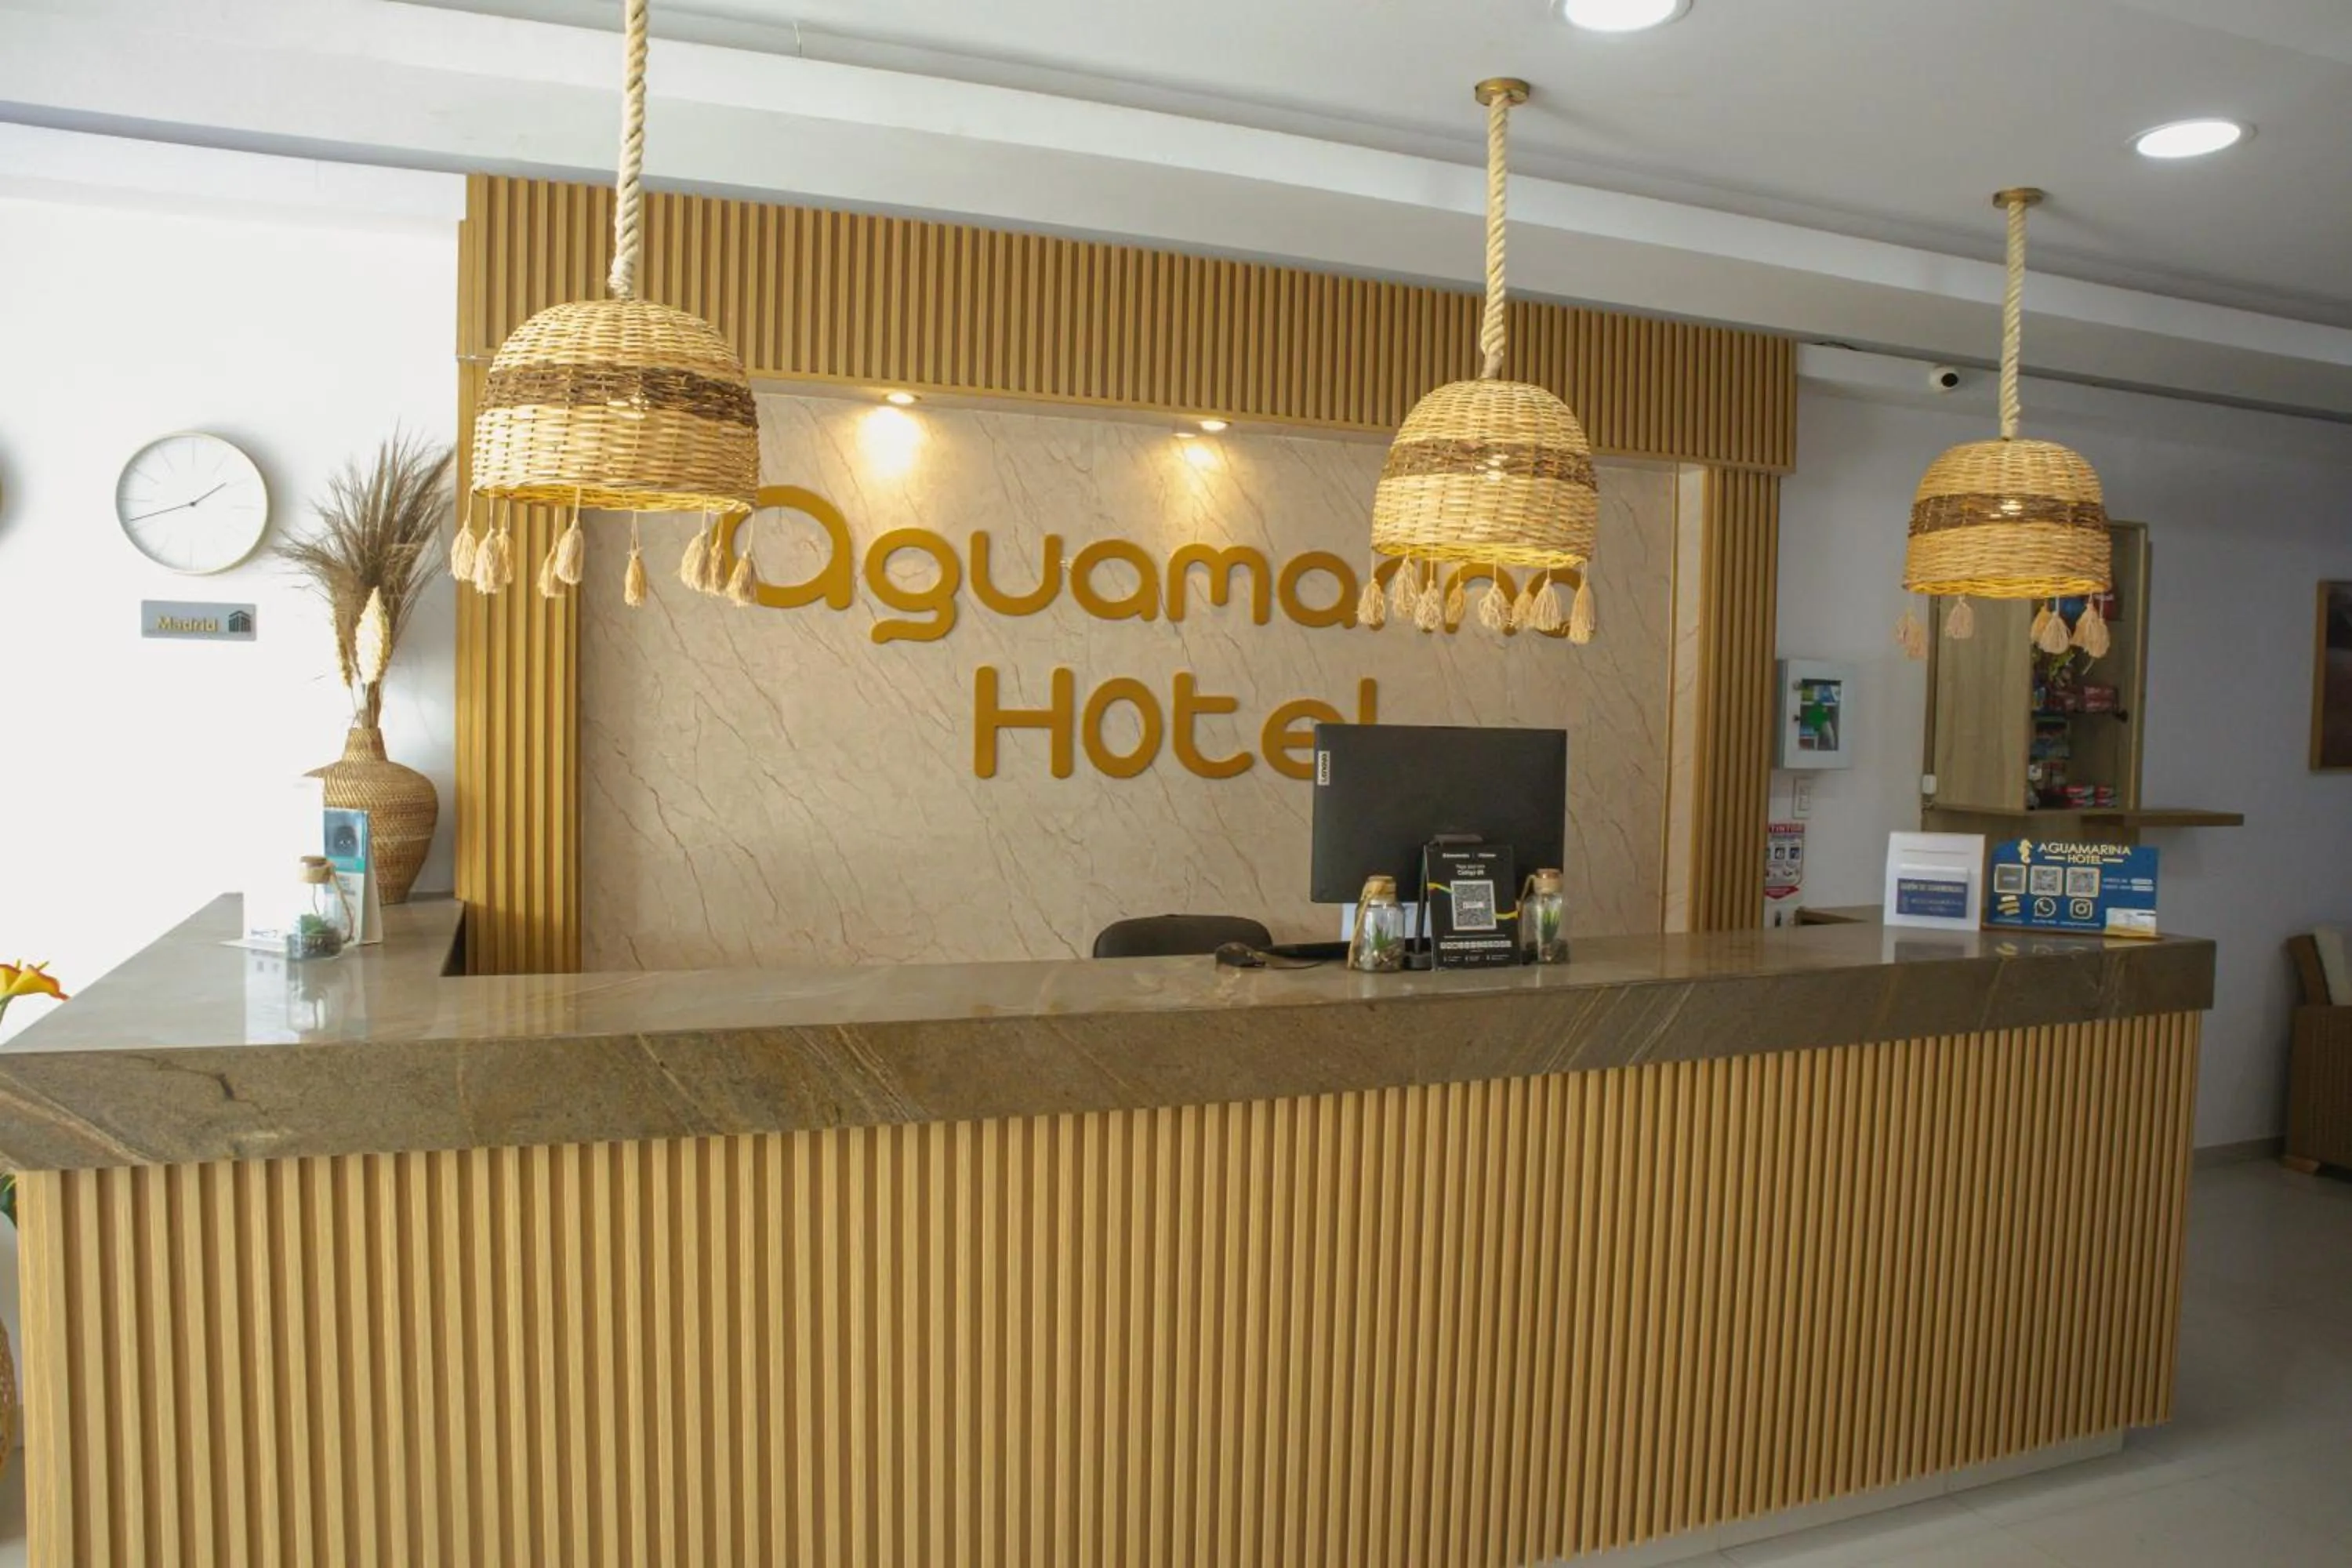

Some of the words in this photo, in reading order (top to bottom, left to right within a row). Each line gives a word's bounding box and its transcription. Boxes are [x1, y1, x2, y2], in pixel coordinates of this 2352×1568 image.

[158, 615, 218, 633] Madrid
[2038, 842, 2131, 856] AGUAMARINA
[2067, 854, 2103, 865] HOTEL
